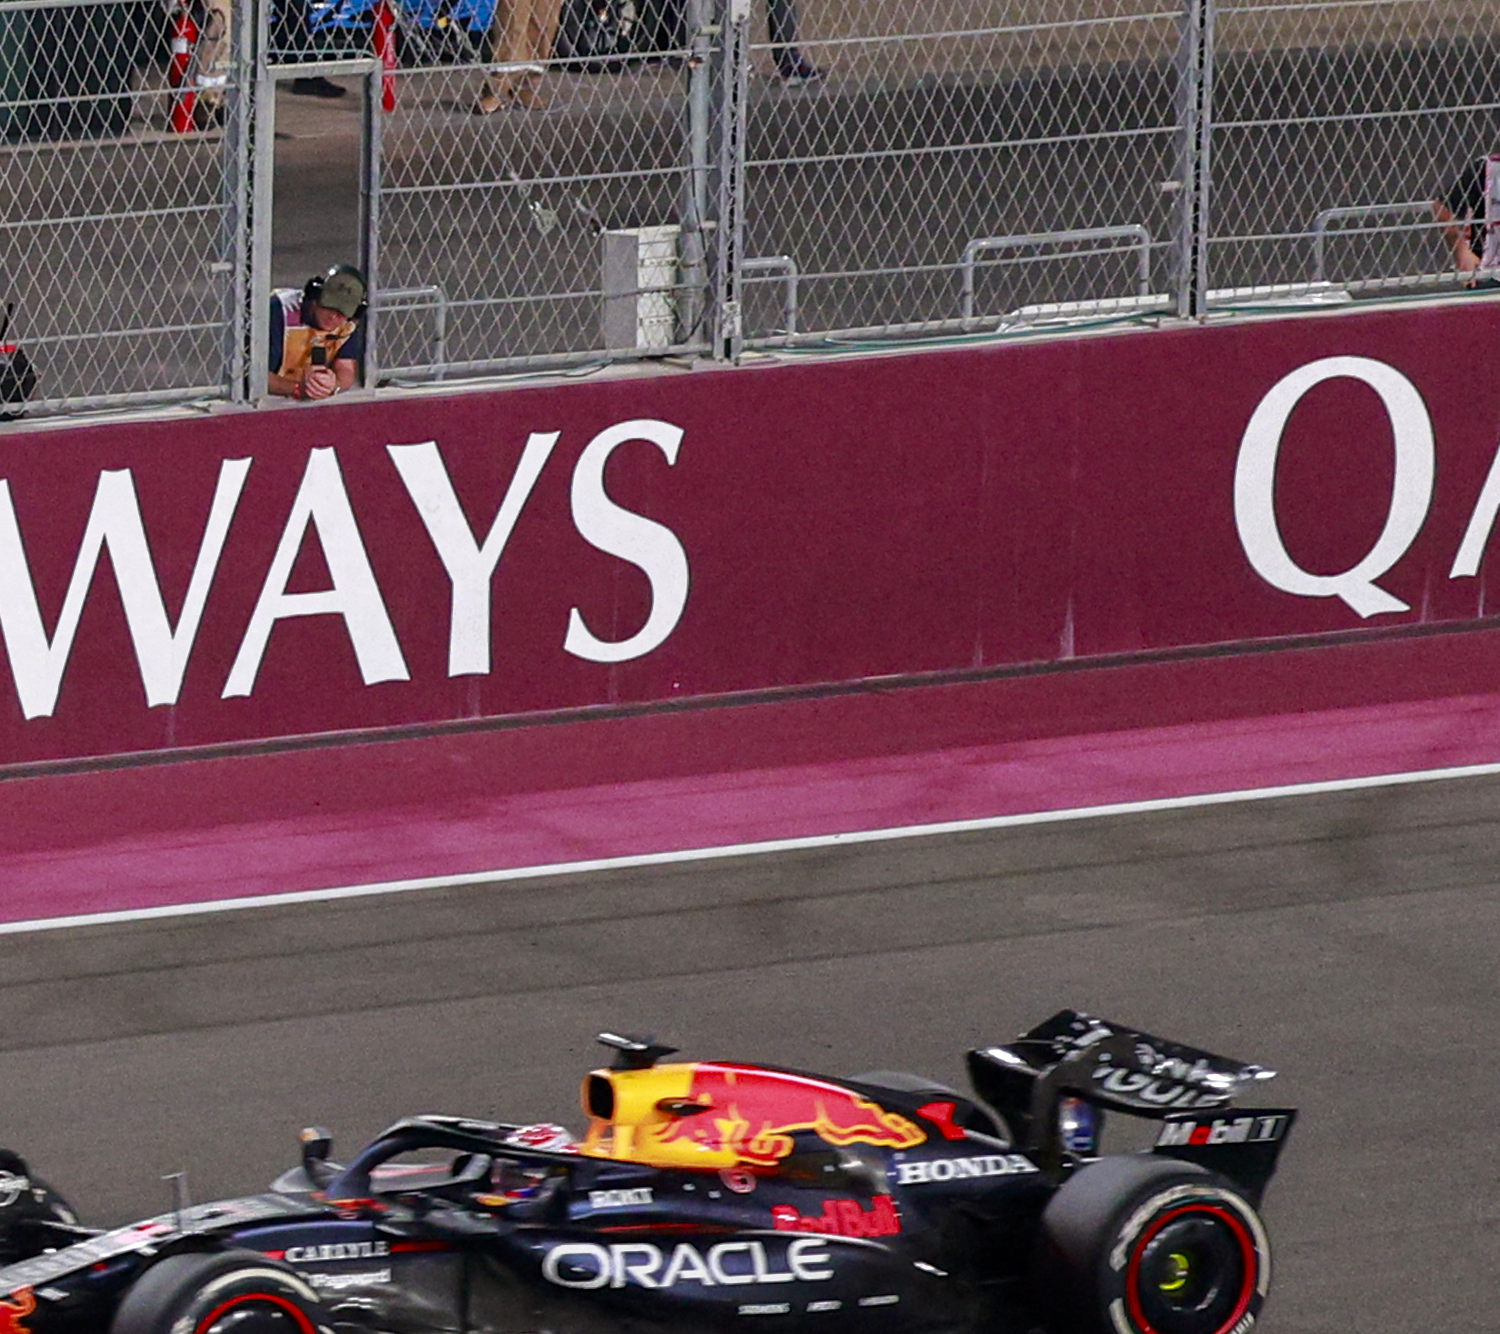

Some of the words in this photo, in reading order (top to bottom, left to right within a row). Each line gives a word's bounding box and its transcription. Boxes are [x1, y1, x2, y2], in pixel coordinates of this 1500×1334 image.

[1234, 355, 1500, 619] Q
[898, 1153, 1040, 1186] HONDA
[542, 1238, 835, 1290] ORACLE
